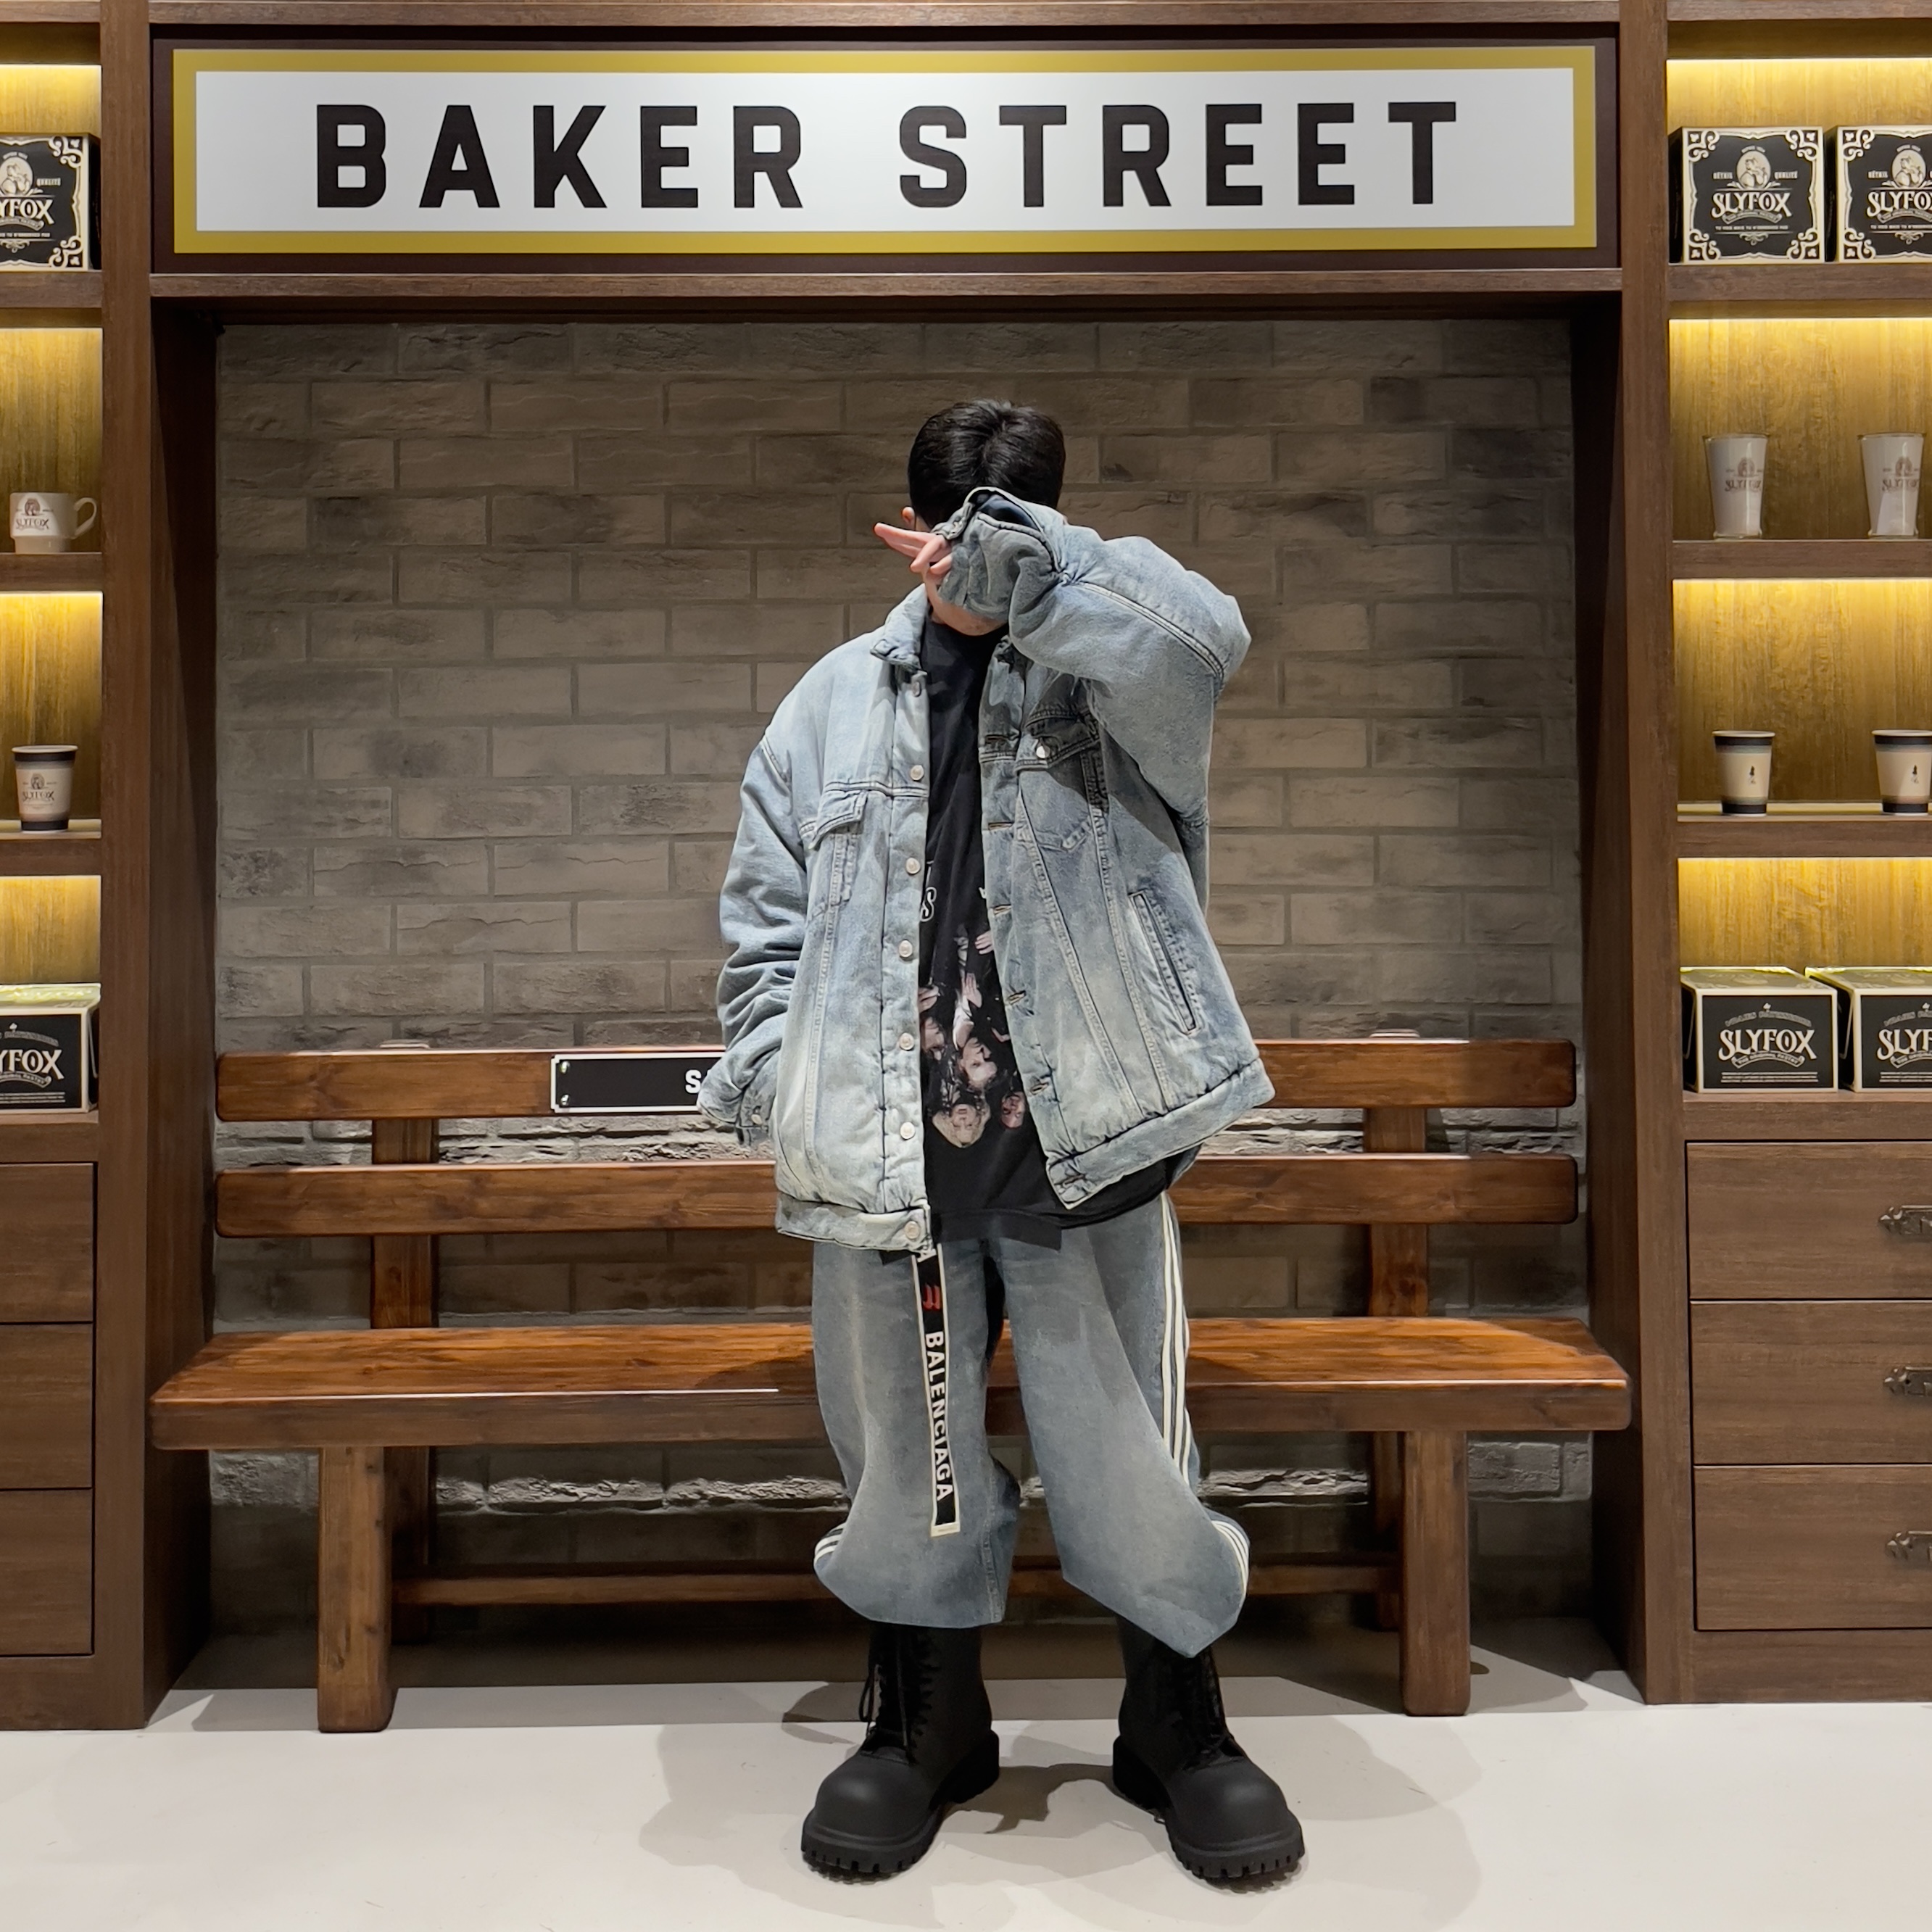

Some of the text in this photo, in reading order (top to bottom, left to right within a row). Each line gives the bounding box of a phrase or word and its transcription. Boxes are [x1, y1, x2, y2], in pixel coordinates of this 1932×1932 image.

[317, 101, 1456, 209] BAKER STREET
[1711, 191, 1793, 218] SLYFOX
[1718, 1029, 1817, 1061] SLYFOX
[684, 1069, 711, 1095] S
[925, 1330, 954, 1502] BALENCIAGA
